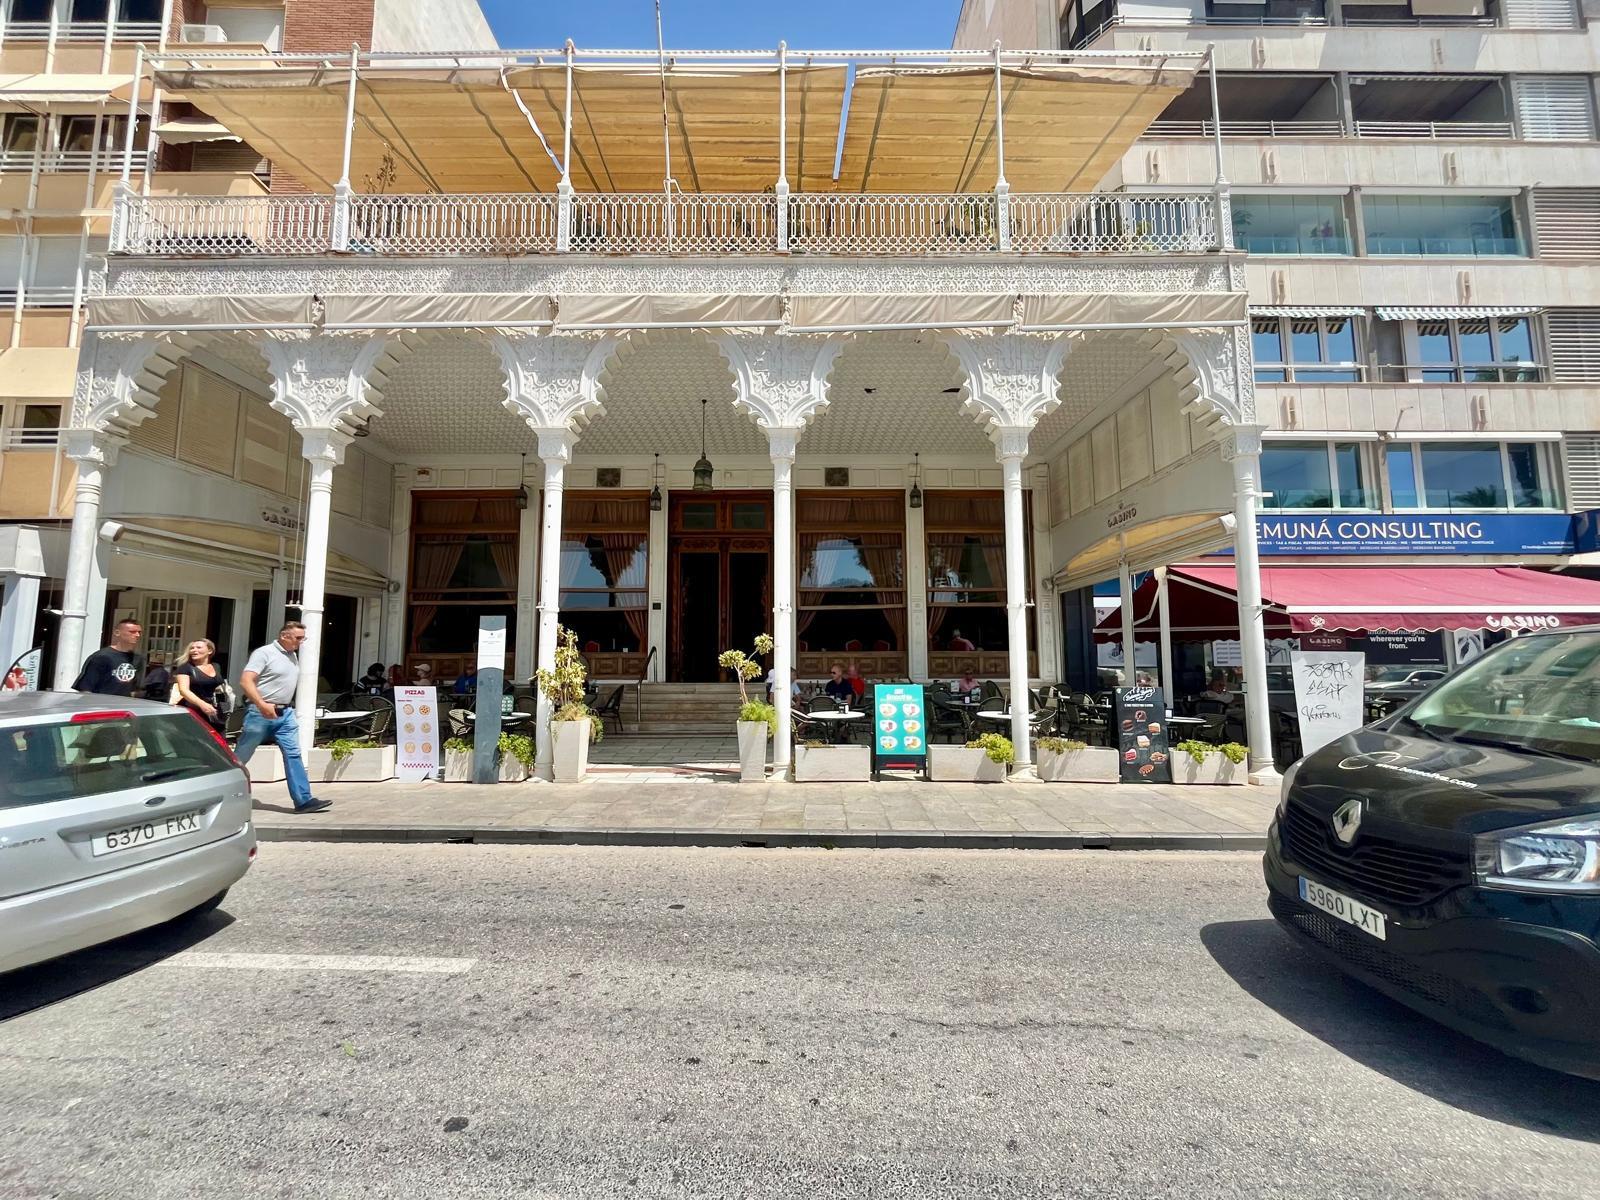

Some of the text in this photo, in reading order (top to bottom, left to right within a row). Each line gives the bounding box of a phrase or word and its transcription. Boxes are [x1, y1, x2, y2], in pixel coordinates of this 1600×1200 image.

[262, 511, 305, 532] CASIN
[1107, 507, 1137, 528] CASINO
[1338, 522, 1482, 539] CONSULTING
[1485, 615, 1560, 628] CASINO
[1404, 636, 1426, 644] you're
[106, 813, 196, 849] 6370 FKX
[1309, 884, 1379, 932] 5960 LXT
